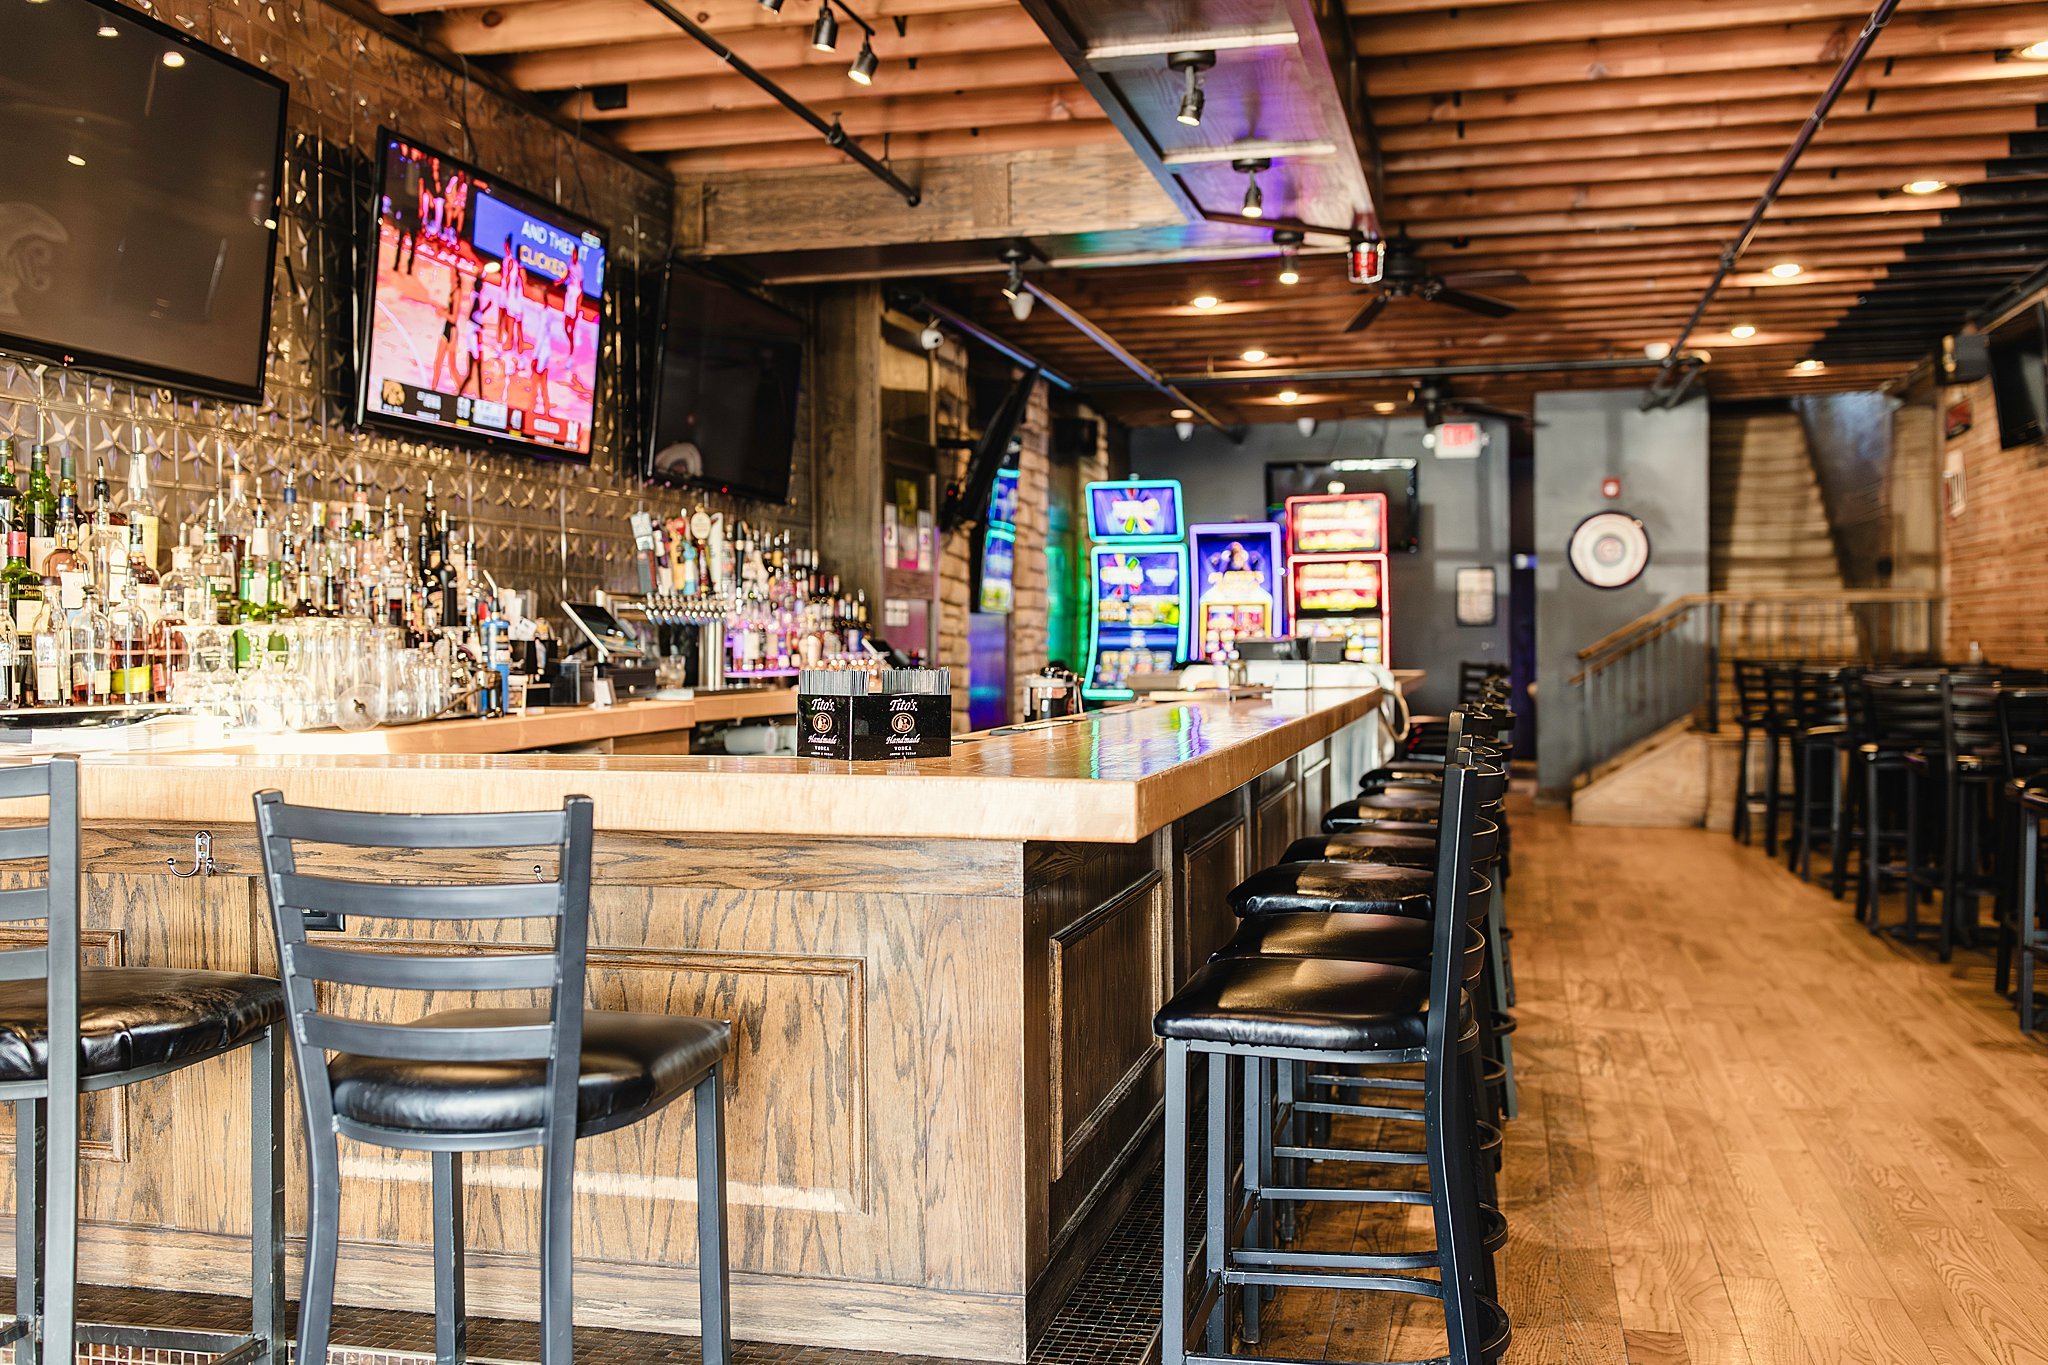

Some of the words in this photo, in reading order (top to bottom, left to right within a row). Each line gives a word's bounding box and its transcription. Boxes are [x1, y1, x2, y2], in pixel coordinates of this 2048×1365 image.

[521, 221, 547, 244] AND
[811, 698, 834, 711] Tito's
[890, 698, 917, 711] Tito's
[808, 733, 837, 744] Handmade
[886, 734, 920, 744] Handmade
